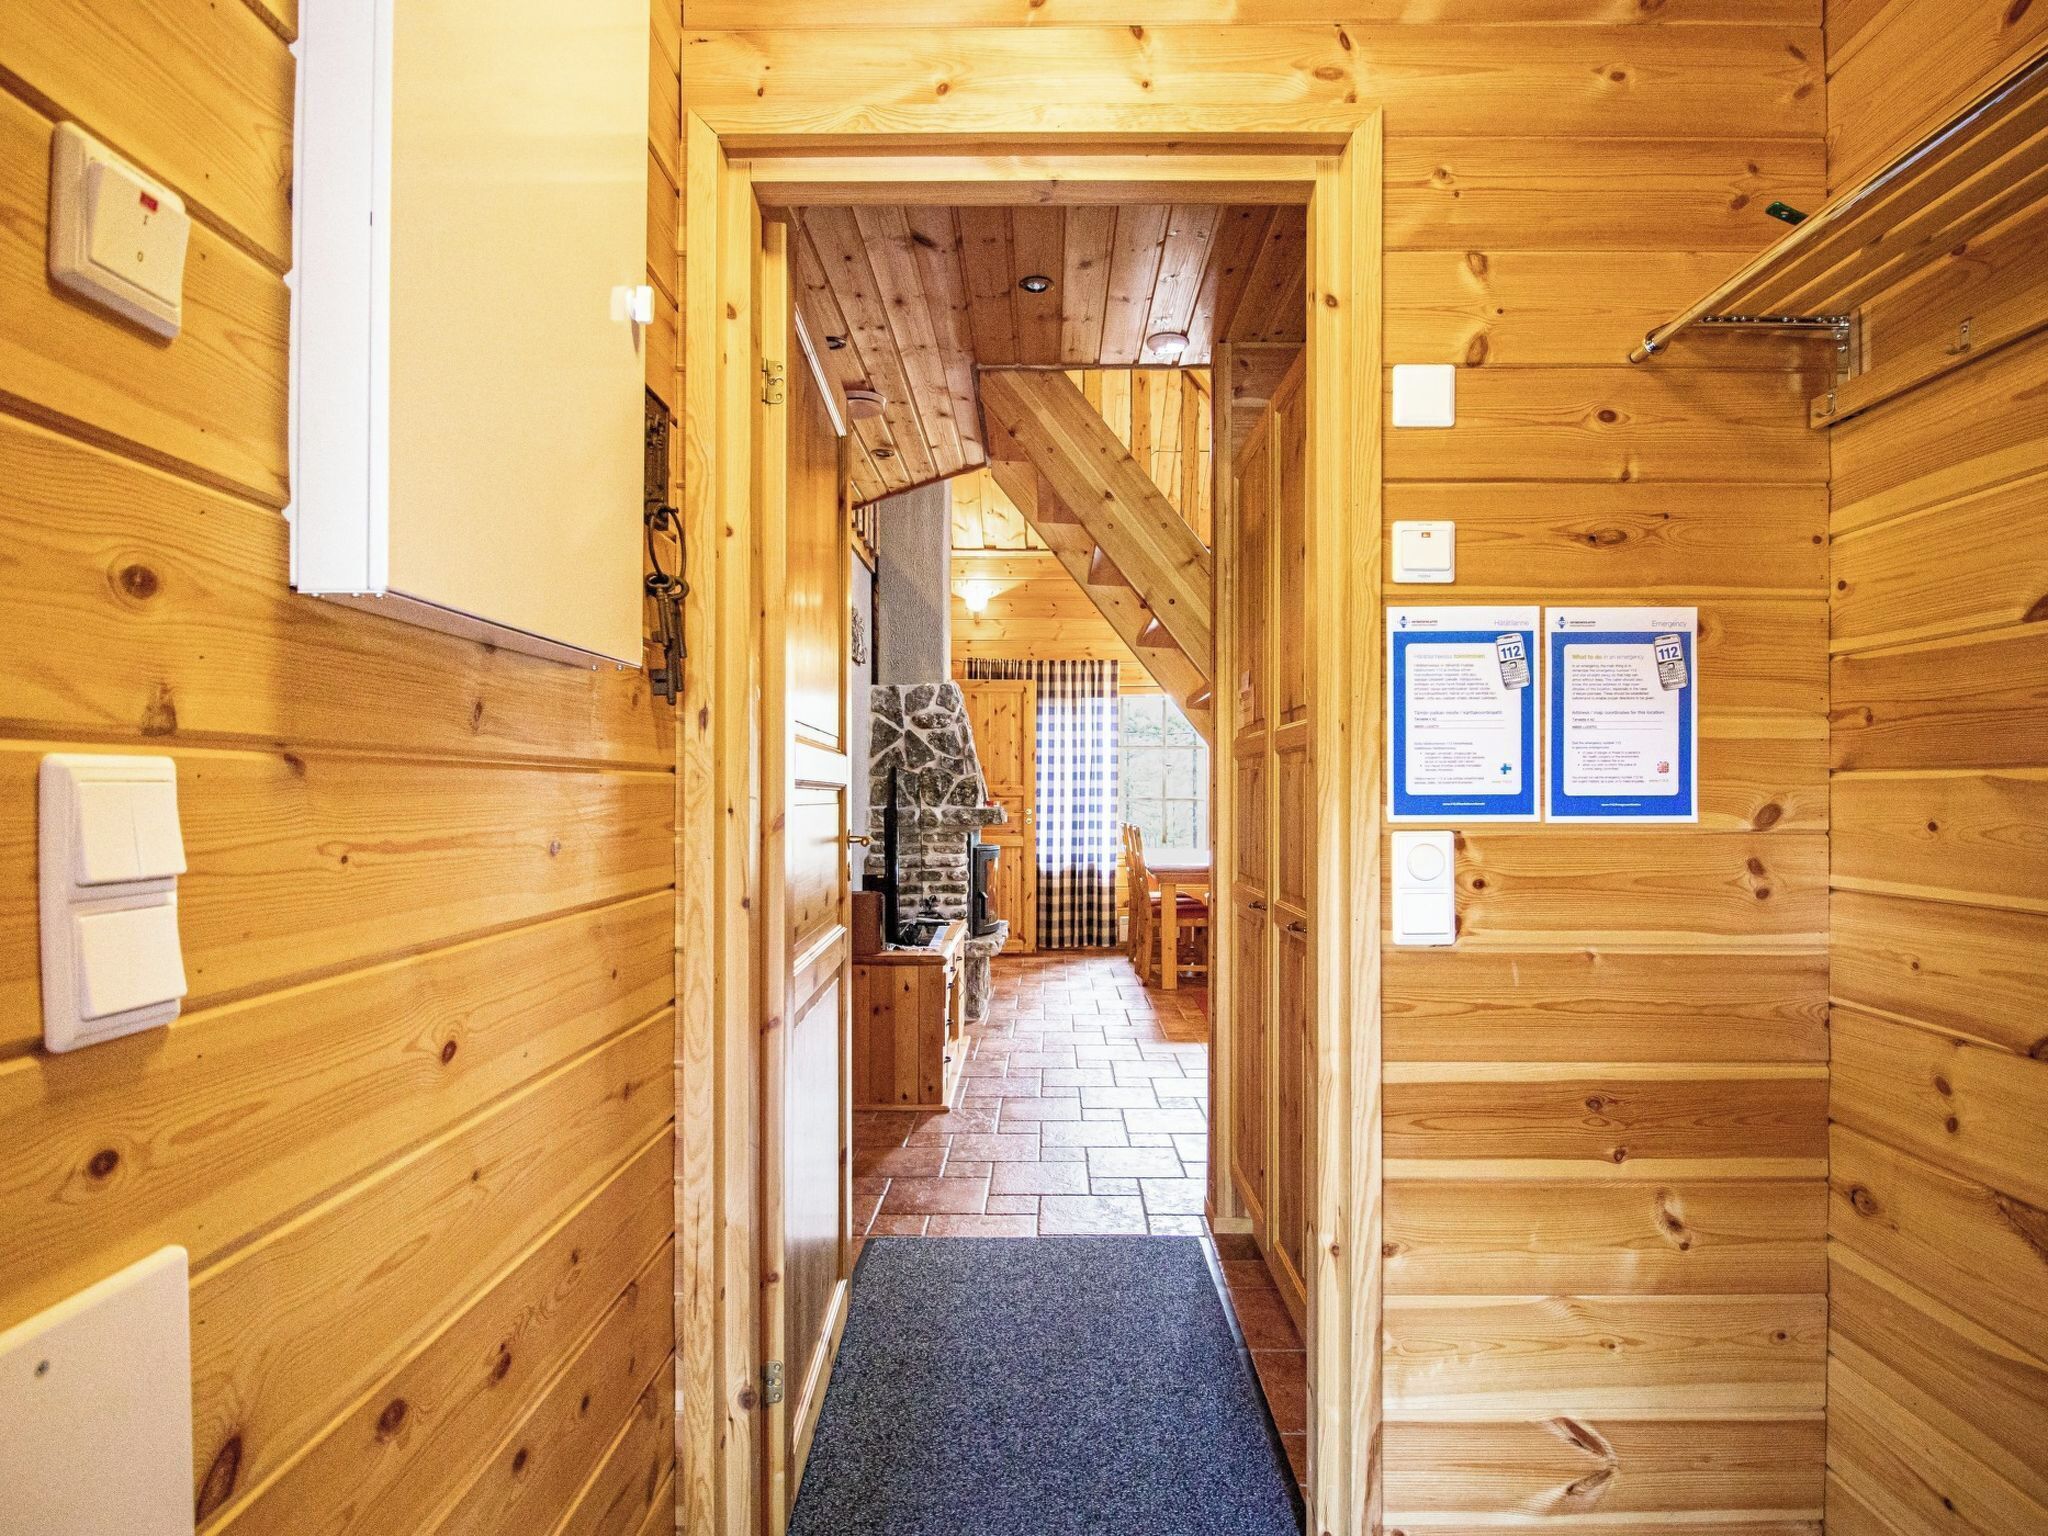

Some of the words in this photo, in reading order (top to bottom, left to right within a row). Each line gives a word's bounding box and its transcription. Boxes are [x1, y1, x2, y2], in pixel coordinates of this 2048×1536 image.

[1651, 620, 1687, 628] Emergency
[1501, 645, 1521, 659] 112
[1658, 646, 1679, 660] 112
